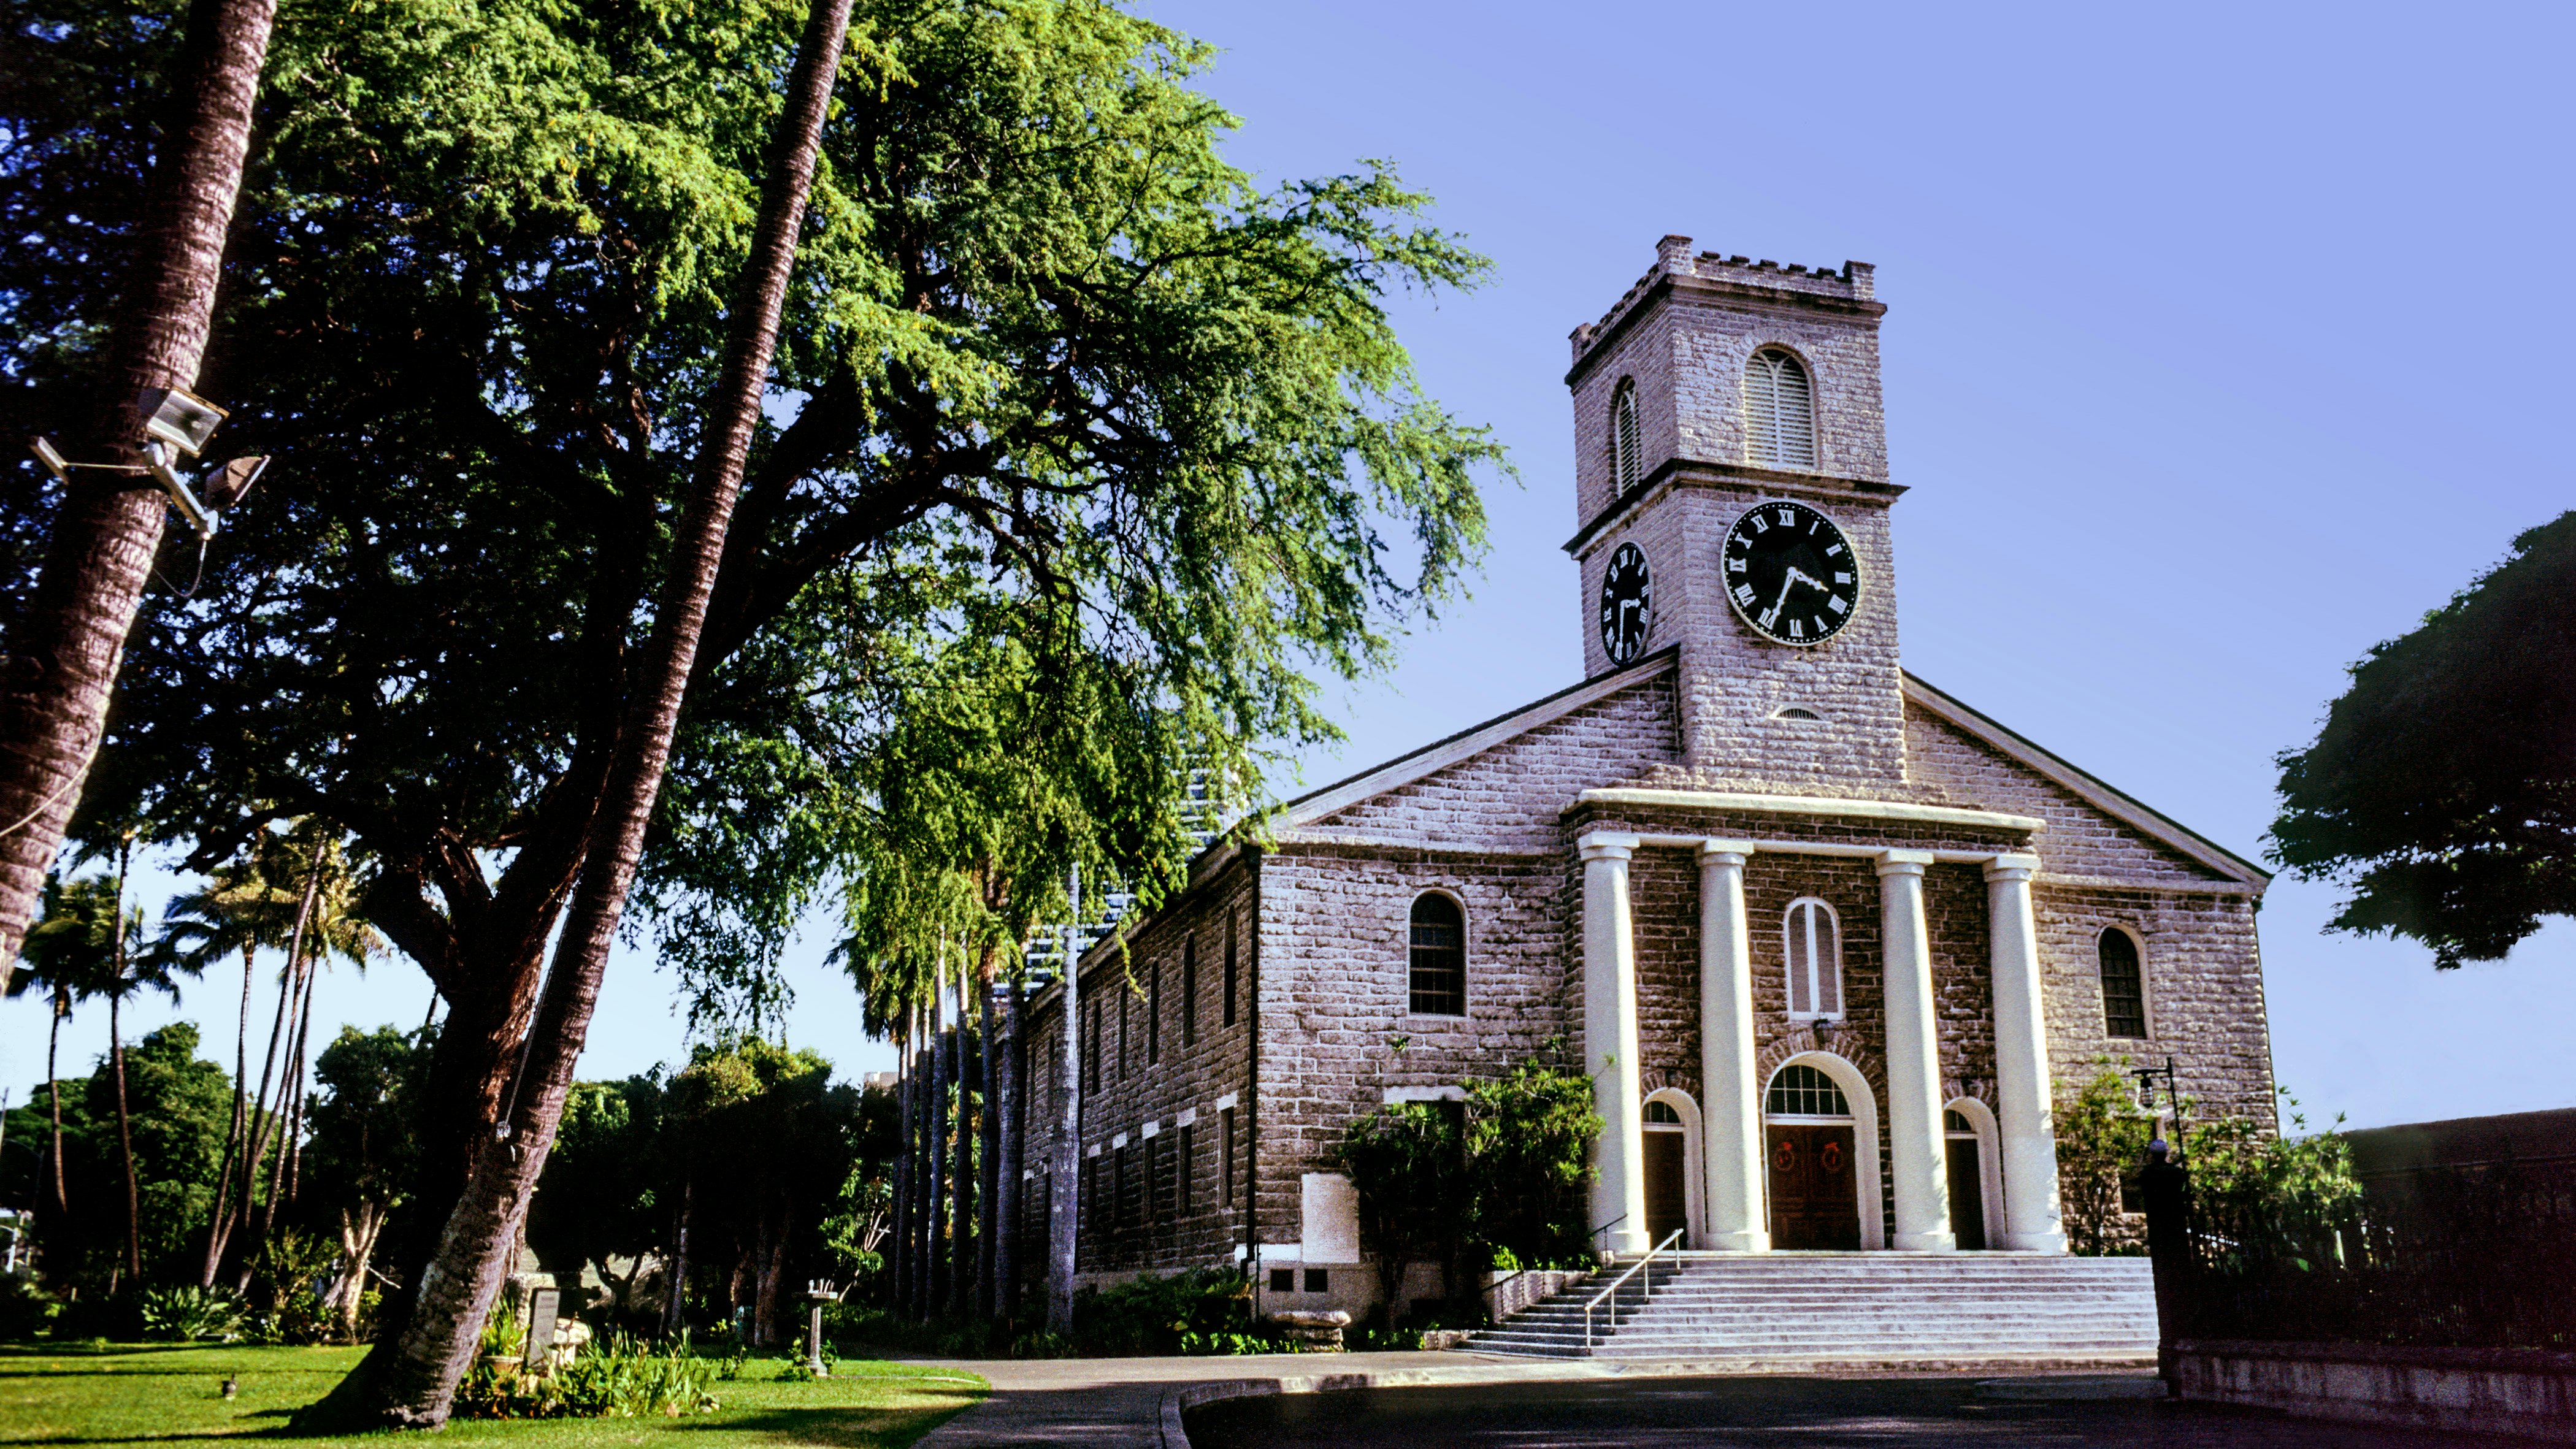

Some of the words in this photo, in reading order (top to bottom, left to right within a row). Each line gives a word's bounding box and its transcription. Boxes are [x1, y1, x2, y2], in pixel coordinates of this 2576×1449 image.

[1751, 514, 1769, 533] XI
[1778, 510, 1795, 527] XII
[1809, 521, 1819, 535] I
[1735, 532, 1753, 549] X
[1826, 543, 1842, 557] II
[1729, 557, 1747, 573] IX
[1835, 571, 1851, 584] III
[1735, 583, 1757, 608] VIII
[1828, 594, 1848, 614] IIII
[1758, 607, 1779, 630] VII
[1814, 614, 1828, 632] V
[1789, 619, 1804, 638] VI
